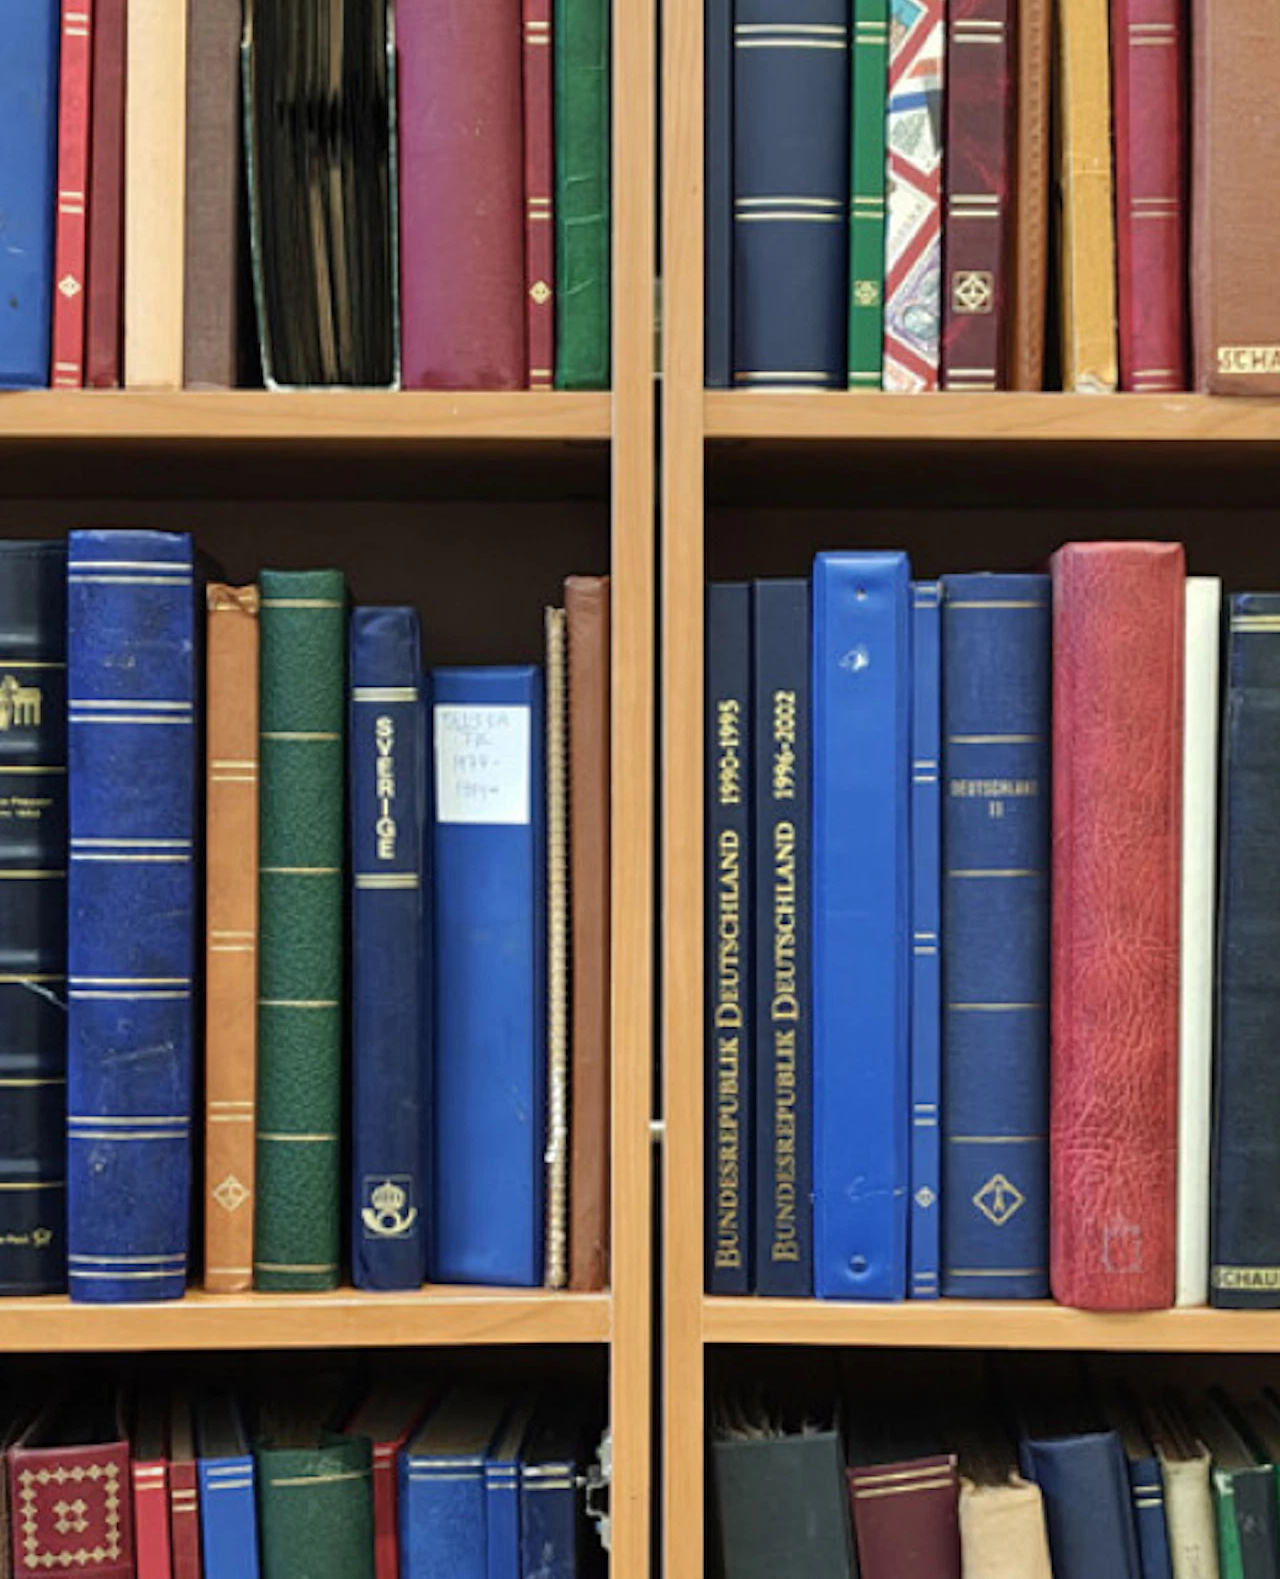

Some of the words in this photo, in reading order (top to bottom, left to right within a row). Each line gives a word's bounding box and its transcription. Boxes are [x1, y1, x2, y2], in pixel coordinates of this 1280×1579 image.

[375, 715, 397, 860] SVERIGE
[773, 689, 796, 800] 1996-2002
[714, 830, 743, 1029] DEUTSCHLAND
[770, 820, 799, 1022] DEUTSCHLAND
[714, 1035, 742, 1269] BUNDESREPUBLIK
[770, 1028, 799, 1263] BUNDESREPUBLIK
